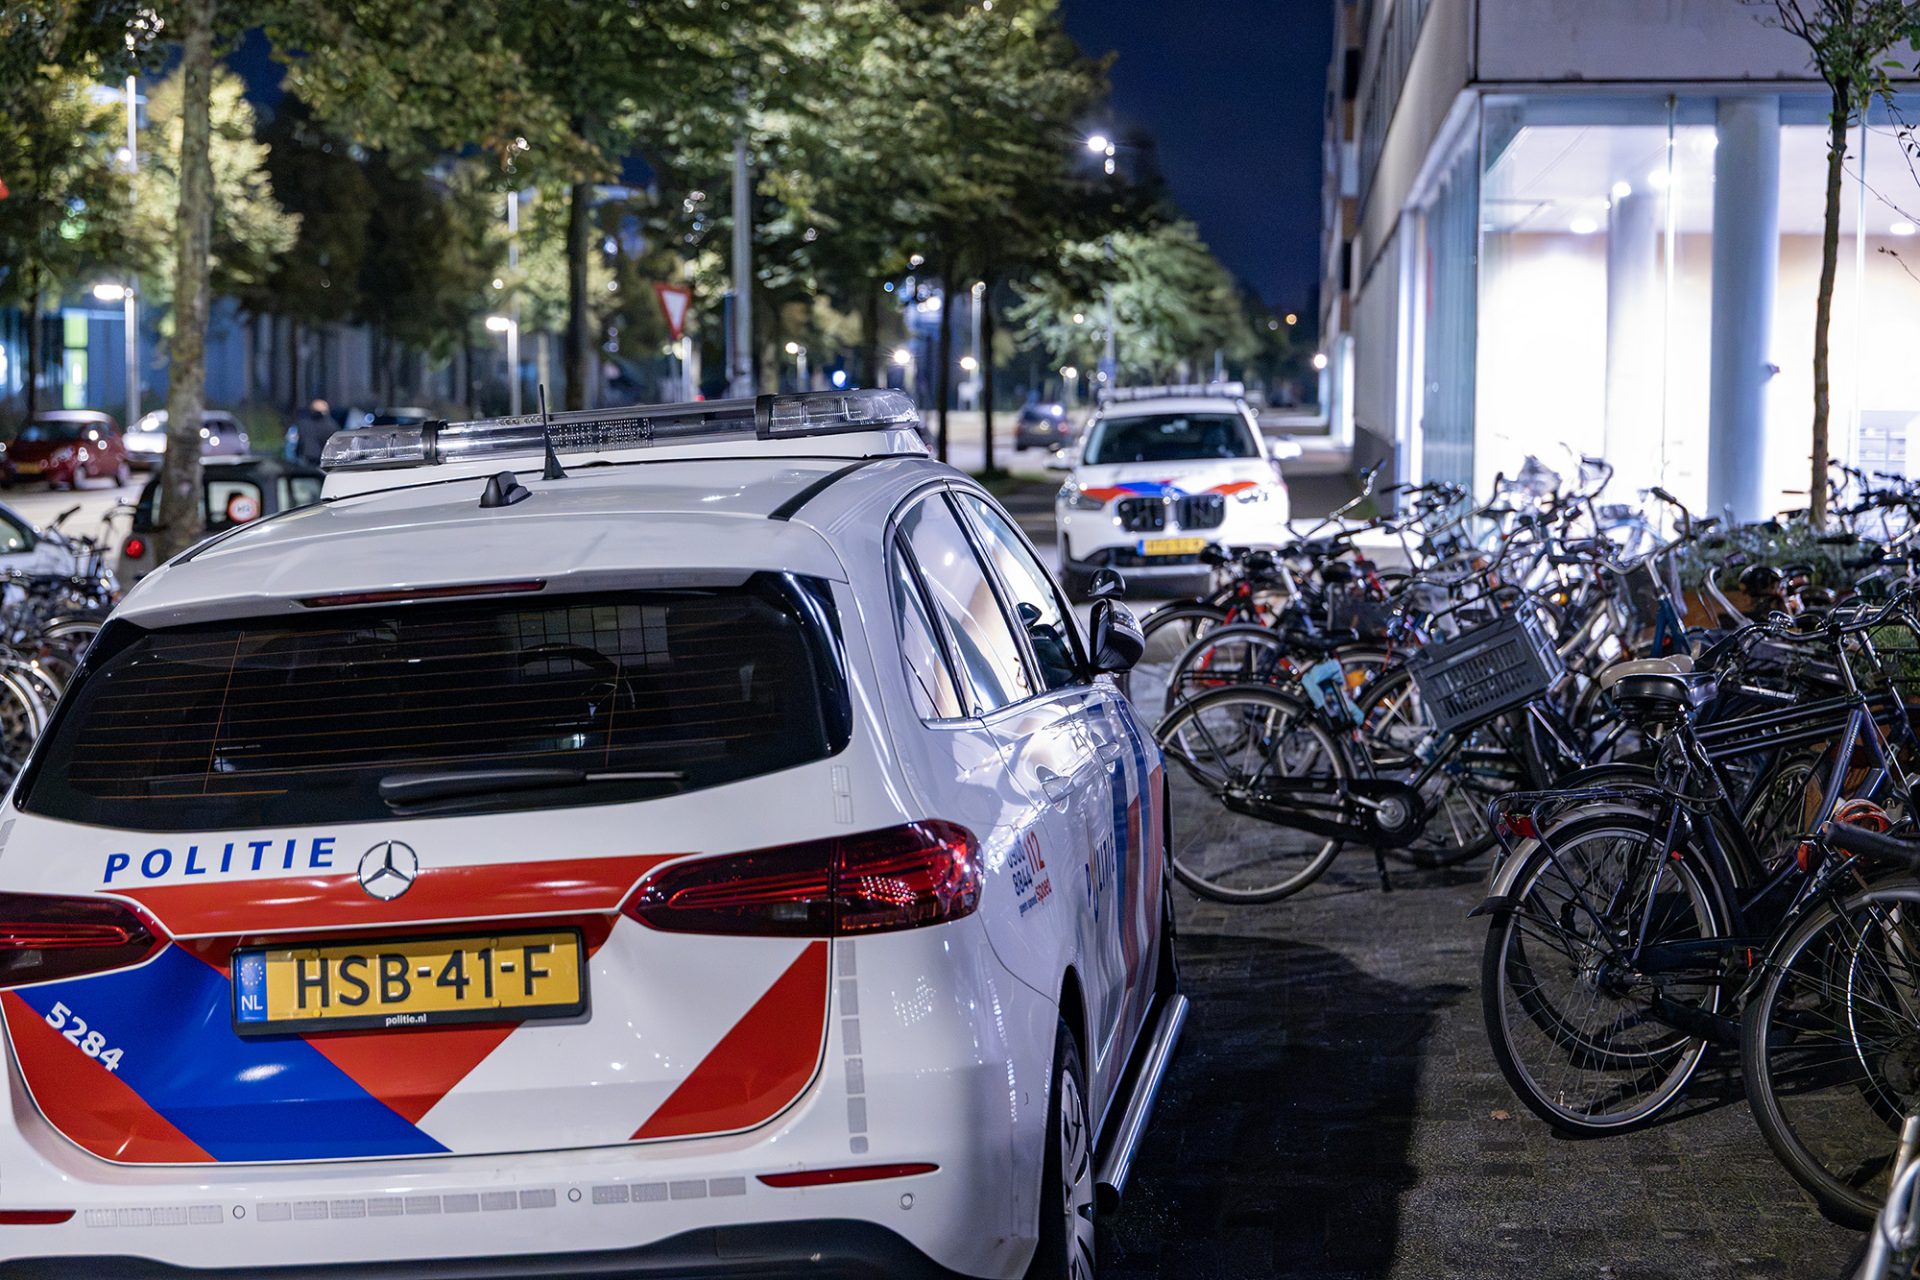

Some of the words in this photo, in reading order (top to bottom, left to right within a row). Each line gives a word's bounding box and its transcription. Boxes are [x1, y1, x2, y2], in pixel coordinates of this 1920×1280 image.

[103, 837, 336, 883] POLITIE
[1023, 831, 1045, 875] 112
[296, 945, 551, 1009] HSB-41-F
[241, 995, 263, 1011] NL
[385, 1013, 427, 1028] politie.nl
[45, 1001, 124, 1072] 5284
